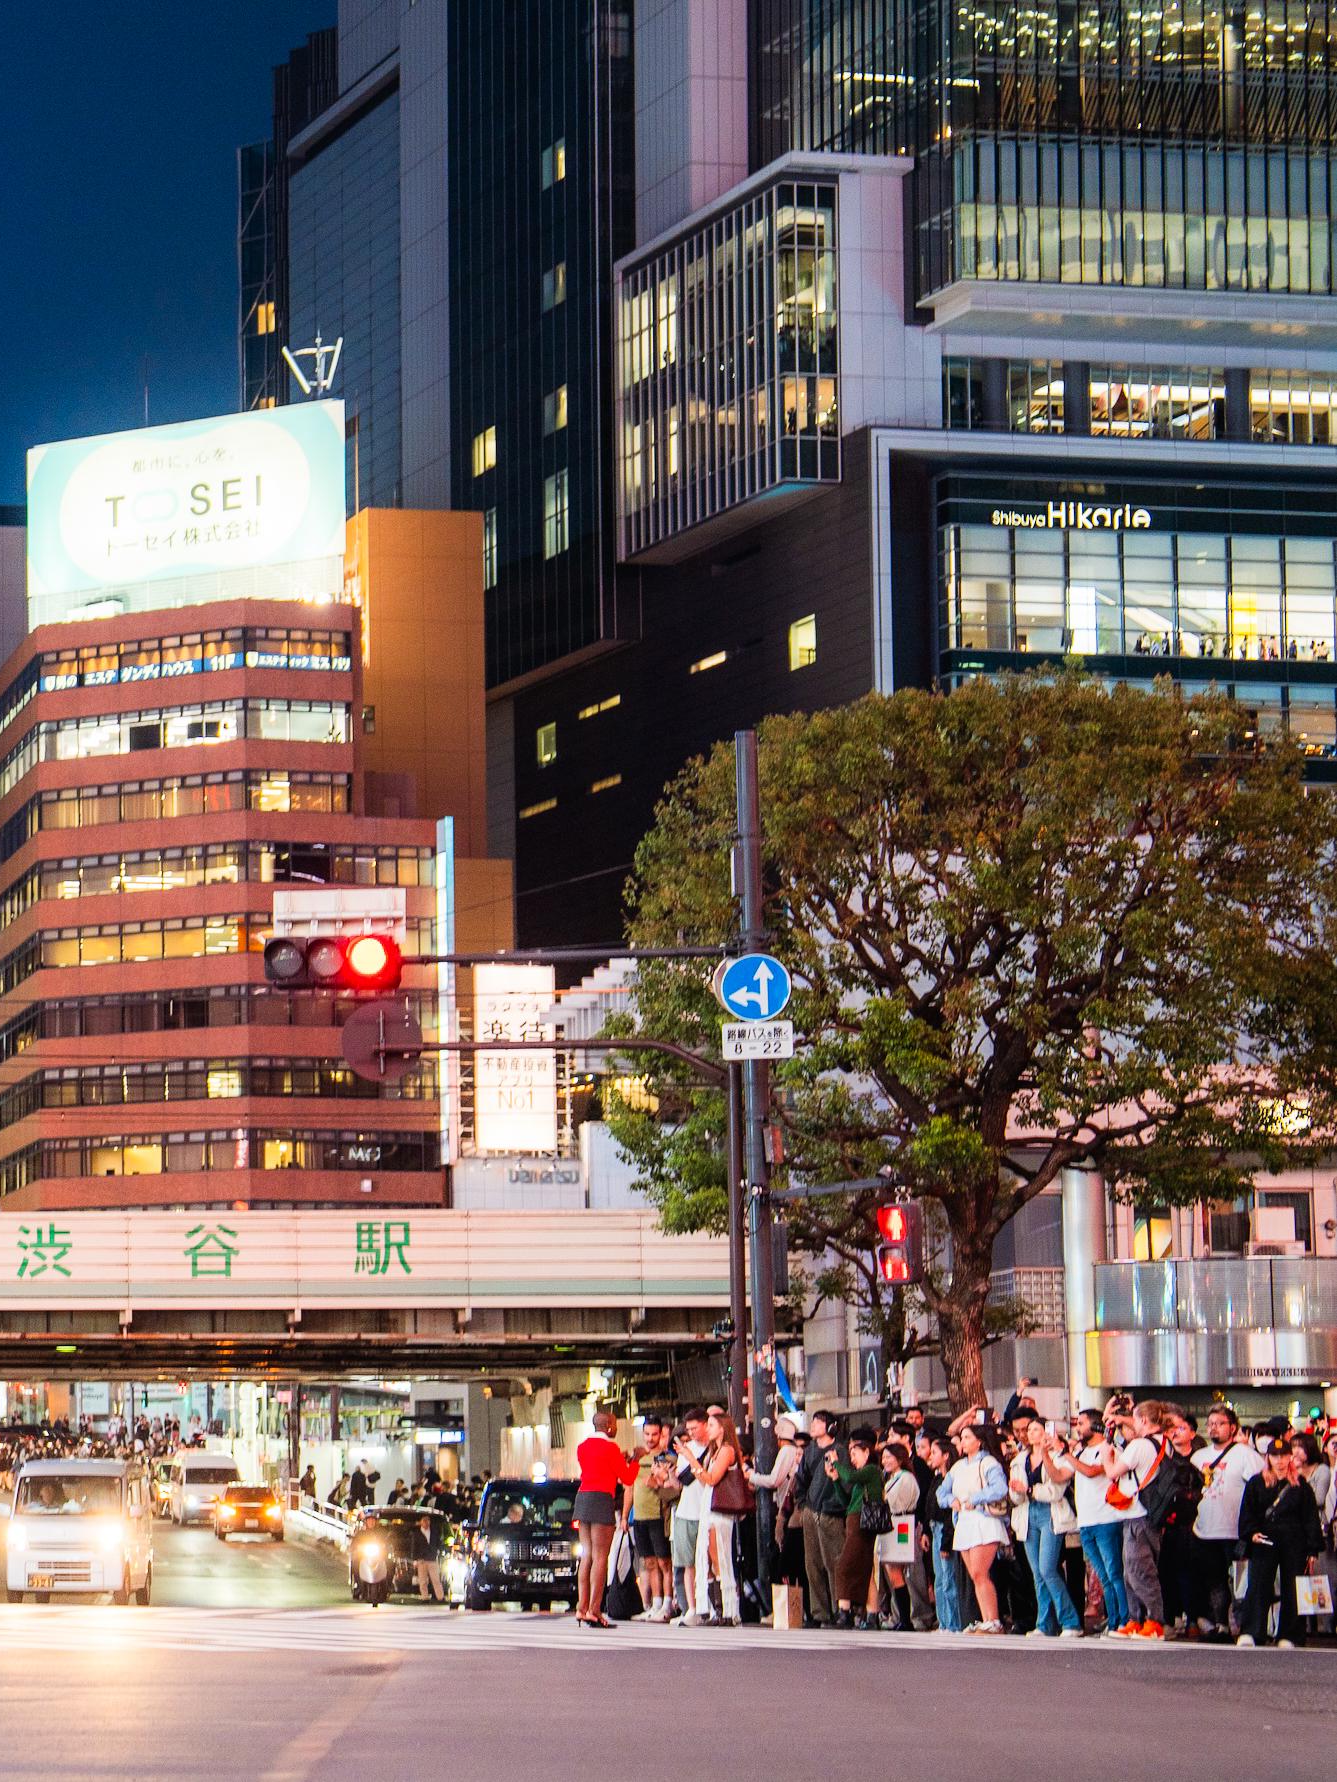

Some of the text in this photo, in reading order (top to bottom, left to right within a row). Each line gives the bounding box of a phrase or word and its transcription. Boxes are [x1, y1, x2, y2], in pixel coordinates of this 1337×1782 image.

[991, 501, 1152, 530] Shibuya Hikarie
[107, 520, 261, 556] トーセイ株式会社
[210, 653, 236, 672] 11F
[763, 1040, 782, 1054] 22
